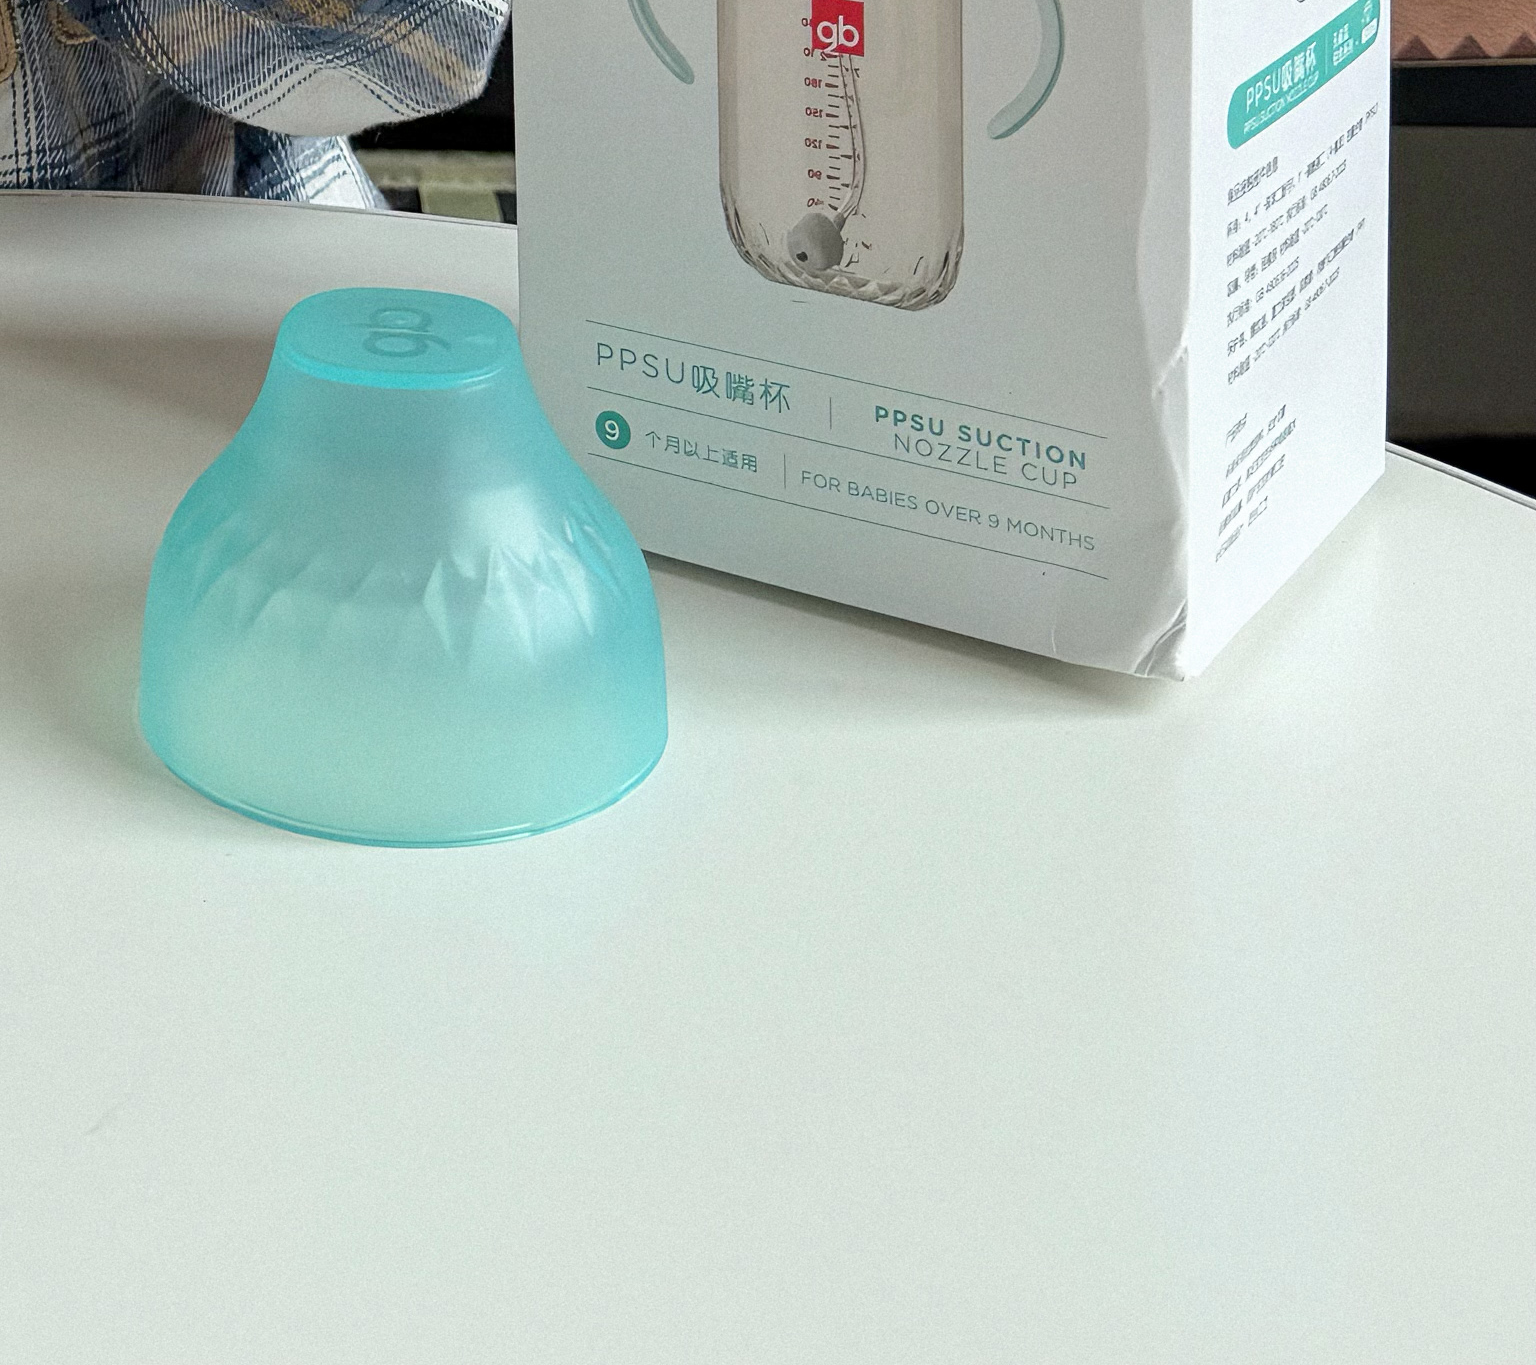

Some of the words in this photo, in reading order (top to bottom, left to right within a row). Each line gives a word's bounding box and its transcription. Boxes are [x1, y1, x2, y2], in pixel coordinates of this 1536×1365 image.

[816, 14, 860, 55] gb
[596, 342, 791, 414] PPSU吸嘴杯
[603, 419, 621, 442] 9
[644, 430, 758, 473] 个月以上适用
[874, 405, 944, 437] PPSU
[957, 424, 1087, 471] SUCTION
[893, 432, 1008, 475] NOZZLE
[1020, 461, 1078, 489] CUP
[800, 469, 841, 493] FOR
[847, 480, 918, 510] BABIES
[924, 499, 982, 526] OVER
[987, 513, 1001, 529] 9
[1006, 516, 1096, 551] MONTHS
